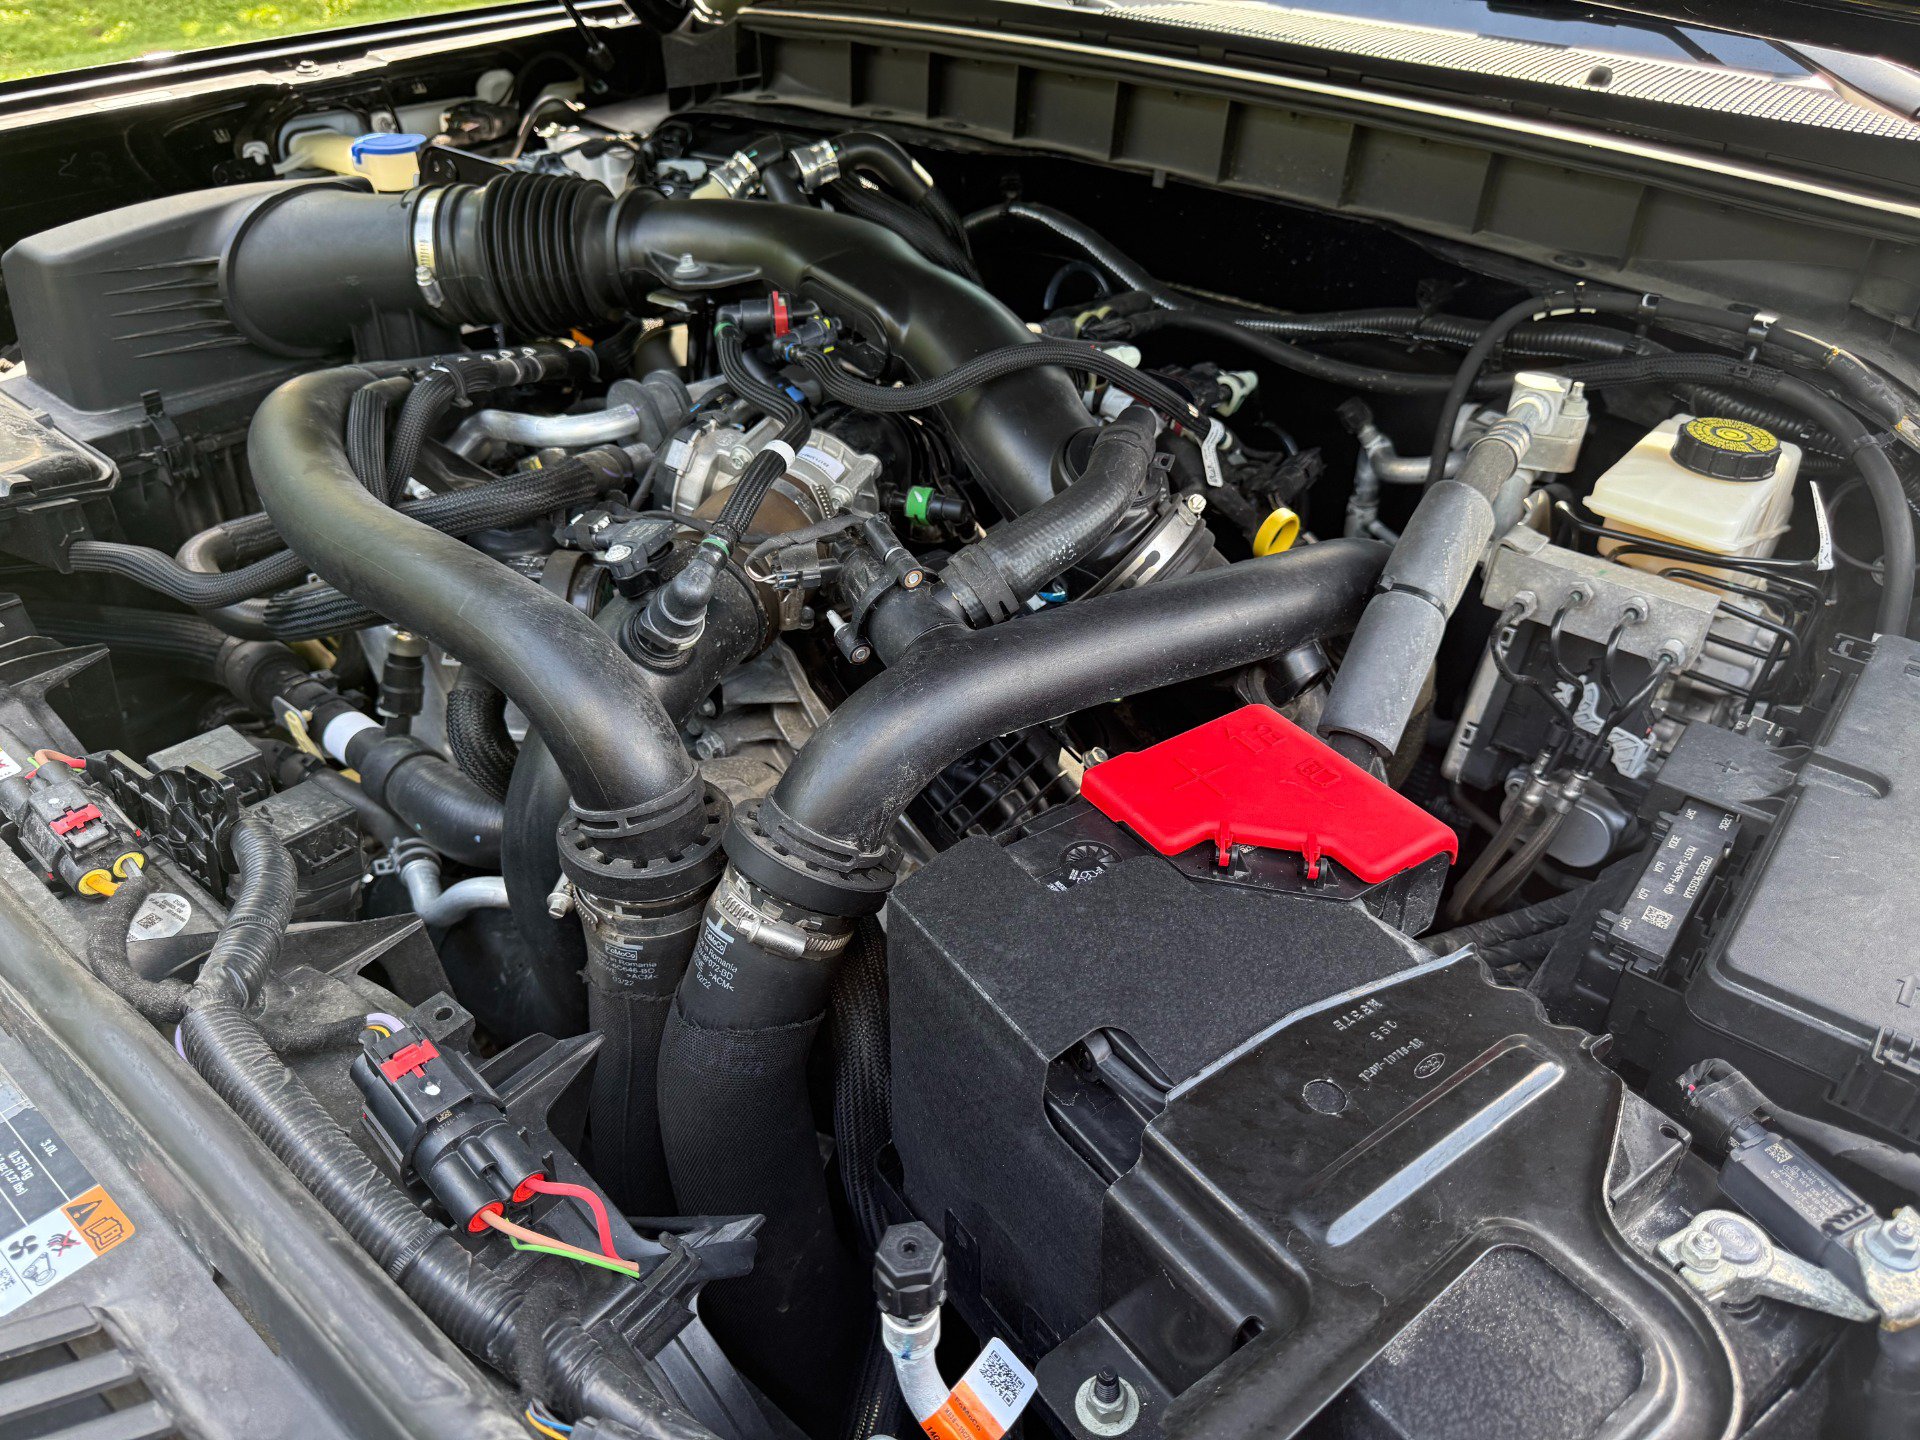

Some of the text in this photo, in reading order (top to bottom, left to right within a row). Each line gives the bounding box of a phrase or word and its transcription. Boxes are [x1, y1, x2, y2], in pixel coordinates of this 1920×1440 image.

[708, 948, 738, 973] Romania
[40, 1138, 58, 1157] 3.0L
[8, 1150, 34, 1181] 0.575 kg
[955, 1397, 980, 1431] FoMoCo
